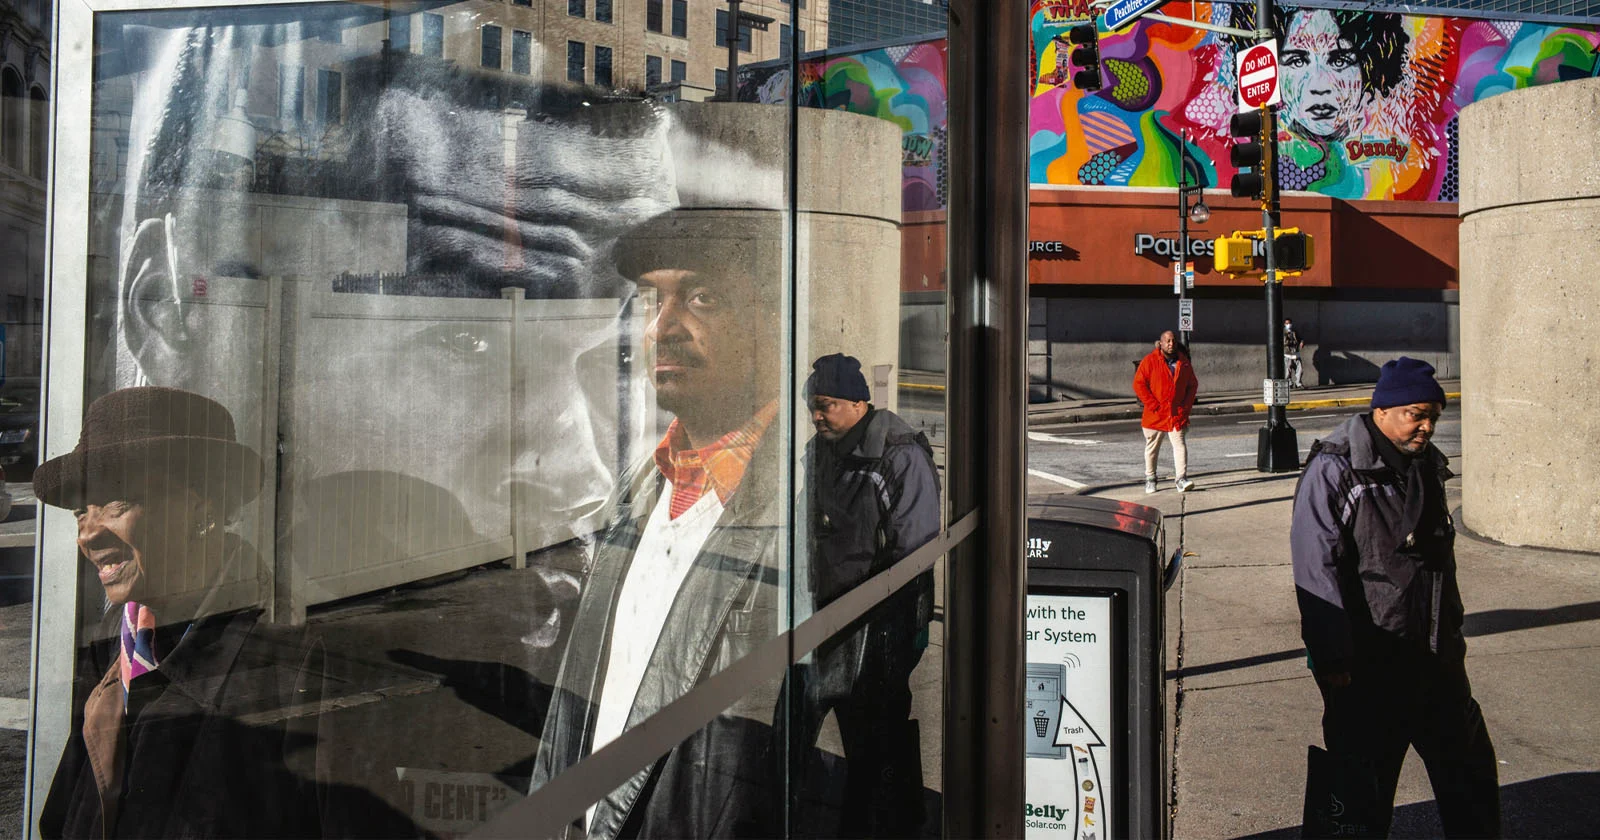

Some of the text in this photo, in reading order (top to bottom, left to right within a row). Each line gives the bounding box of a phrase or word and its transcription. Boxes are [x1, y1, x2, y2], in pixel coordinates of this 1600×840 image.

[1245, 54, 1272, 72] DO NOT
[1247, 82, 1270, 99] ENTER
[1345, 137, 1409, 162] Dandy
[1061, 606, 1086, 621] the
[1044, 628, 1097, 645] System
[1063, 726, 1084, 735] Trash
[1026, 820, 1067, 830] Solar.com
